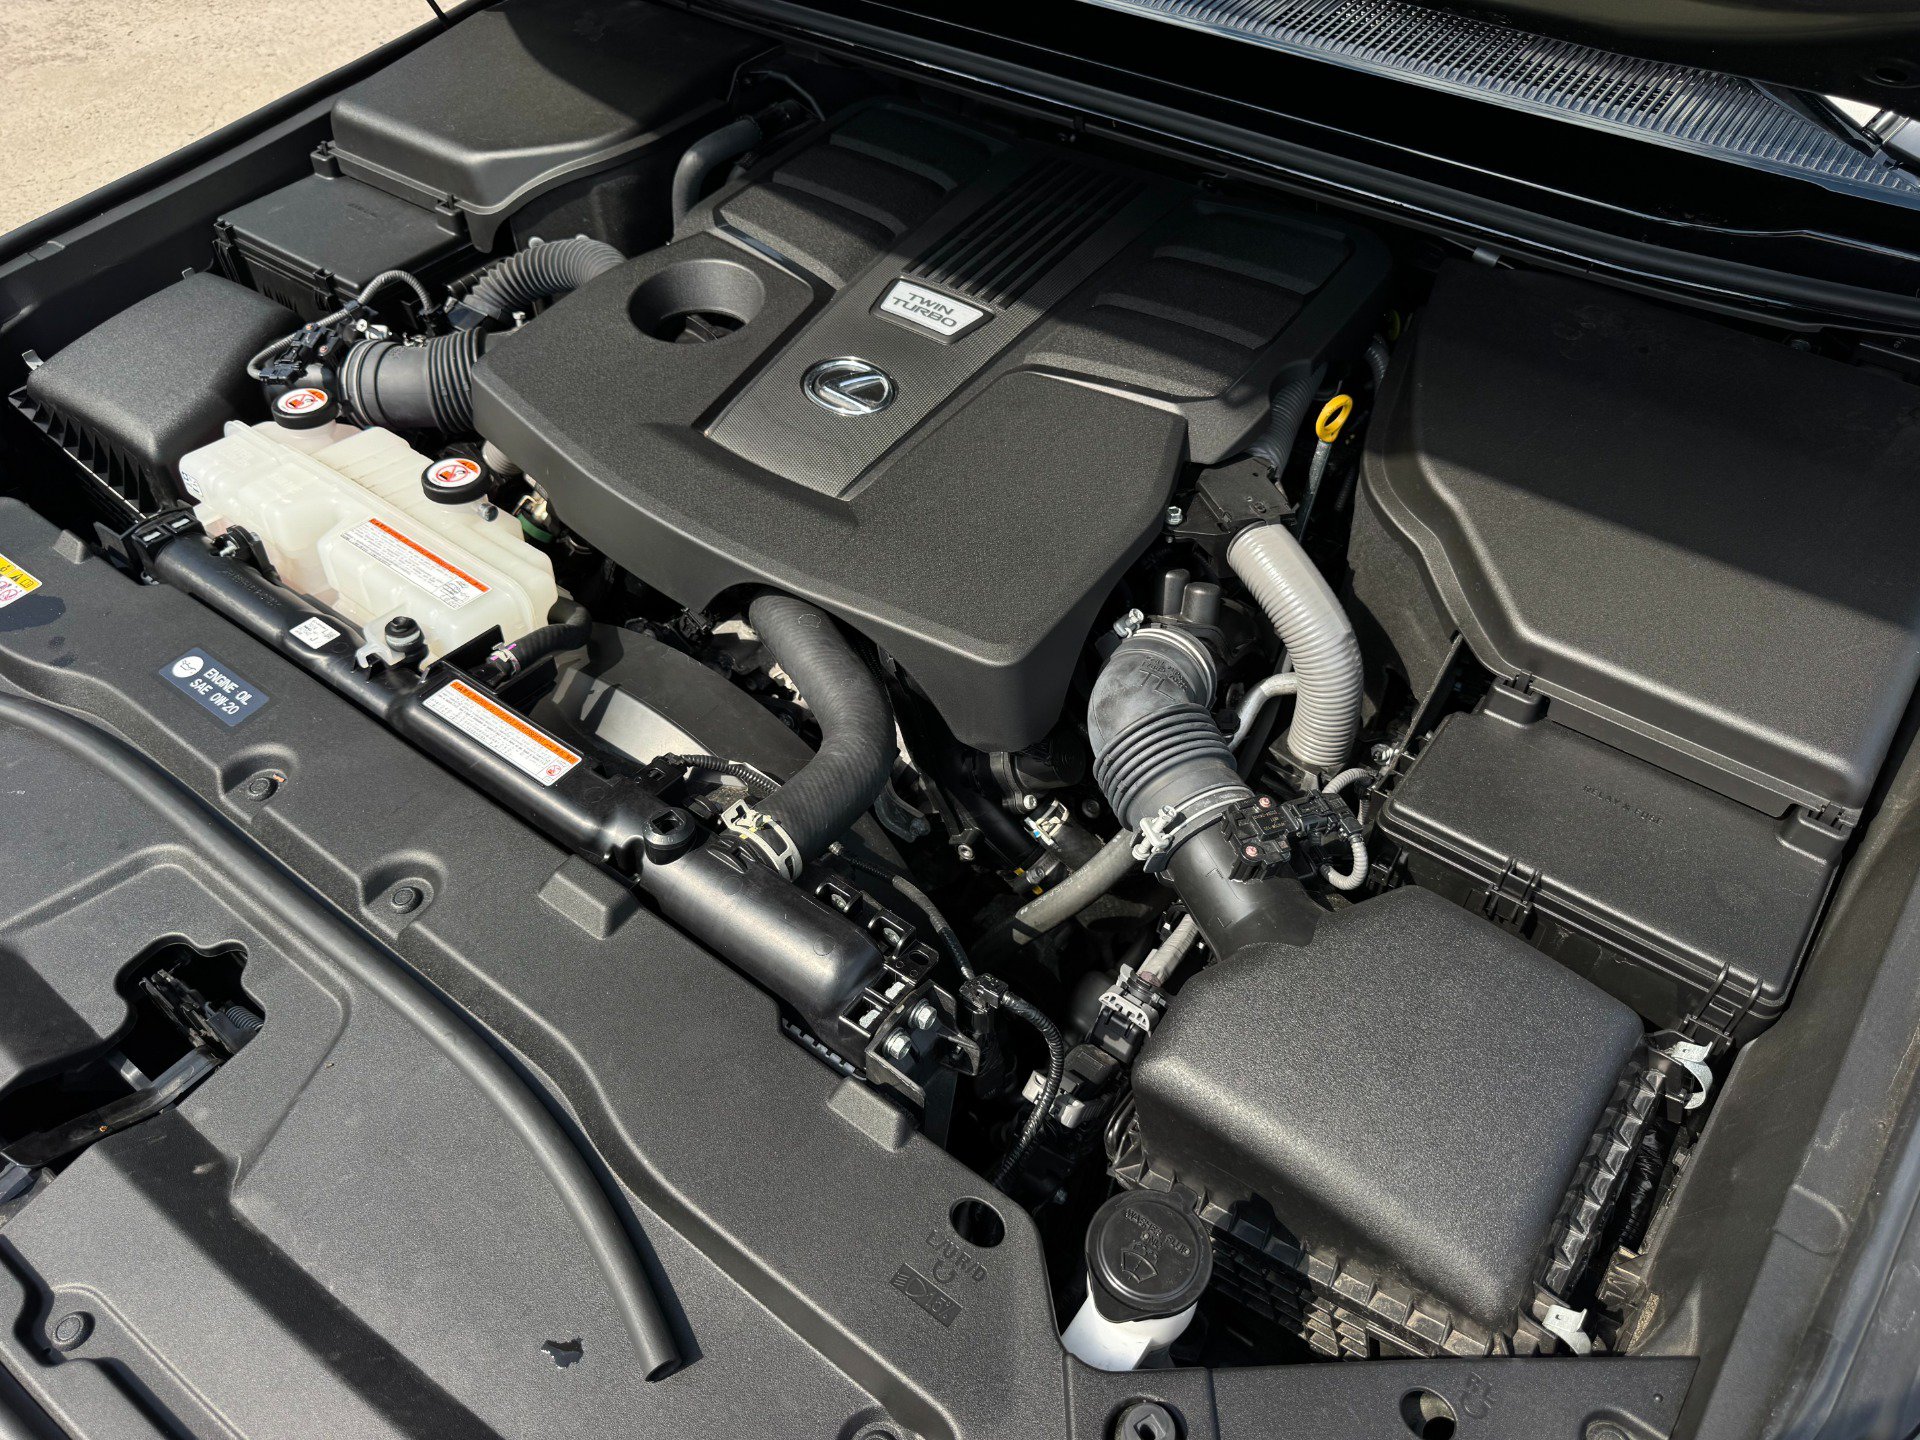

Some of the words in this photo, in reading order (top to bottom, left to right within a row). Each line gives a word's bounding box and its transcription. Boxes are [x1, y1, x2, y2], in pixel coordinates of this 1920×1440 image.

[892, 297, 957, 327] TURBO
[909, 292, 955, 315] TWIN
[189, 678, 213, 695] SAE
[209, 692, 240, 715] 0W-20
[203, 668, 238, 693] ENGINE
[235, 690, 253, 705] OIL
[1584, 785, 1618, 805] RELAY
[1634, 808, 1664, 826] FUSE
[1124, 1208, 1164, 1237] WASHER
[1165, 1234, 1192, 1257] FLUID
[1140, 1231, 1164, 1250] ONLY
